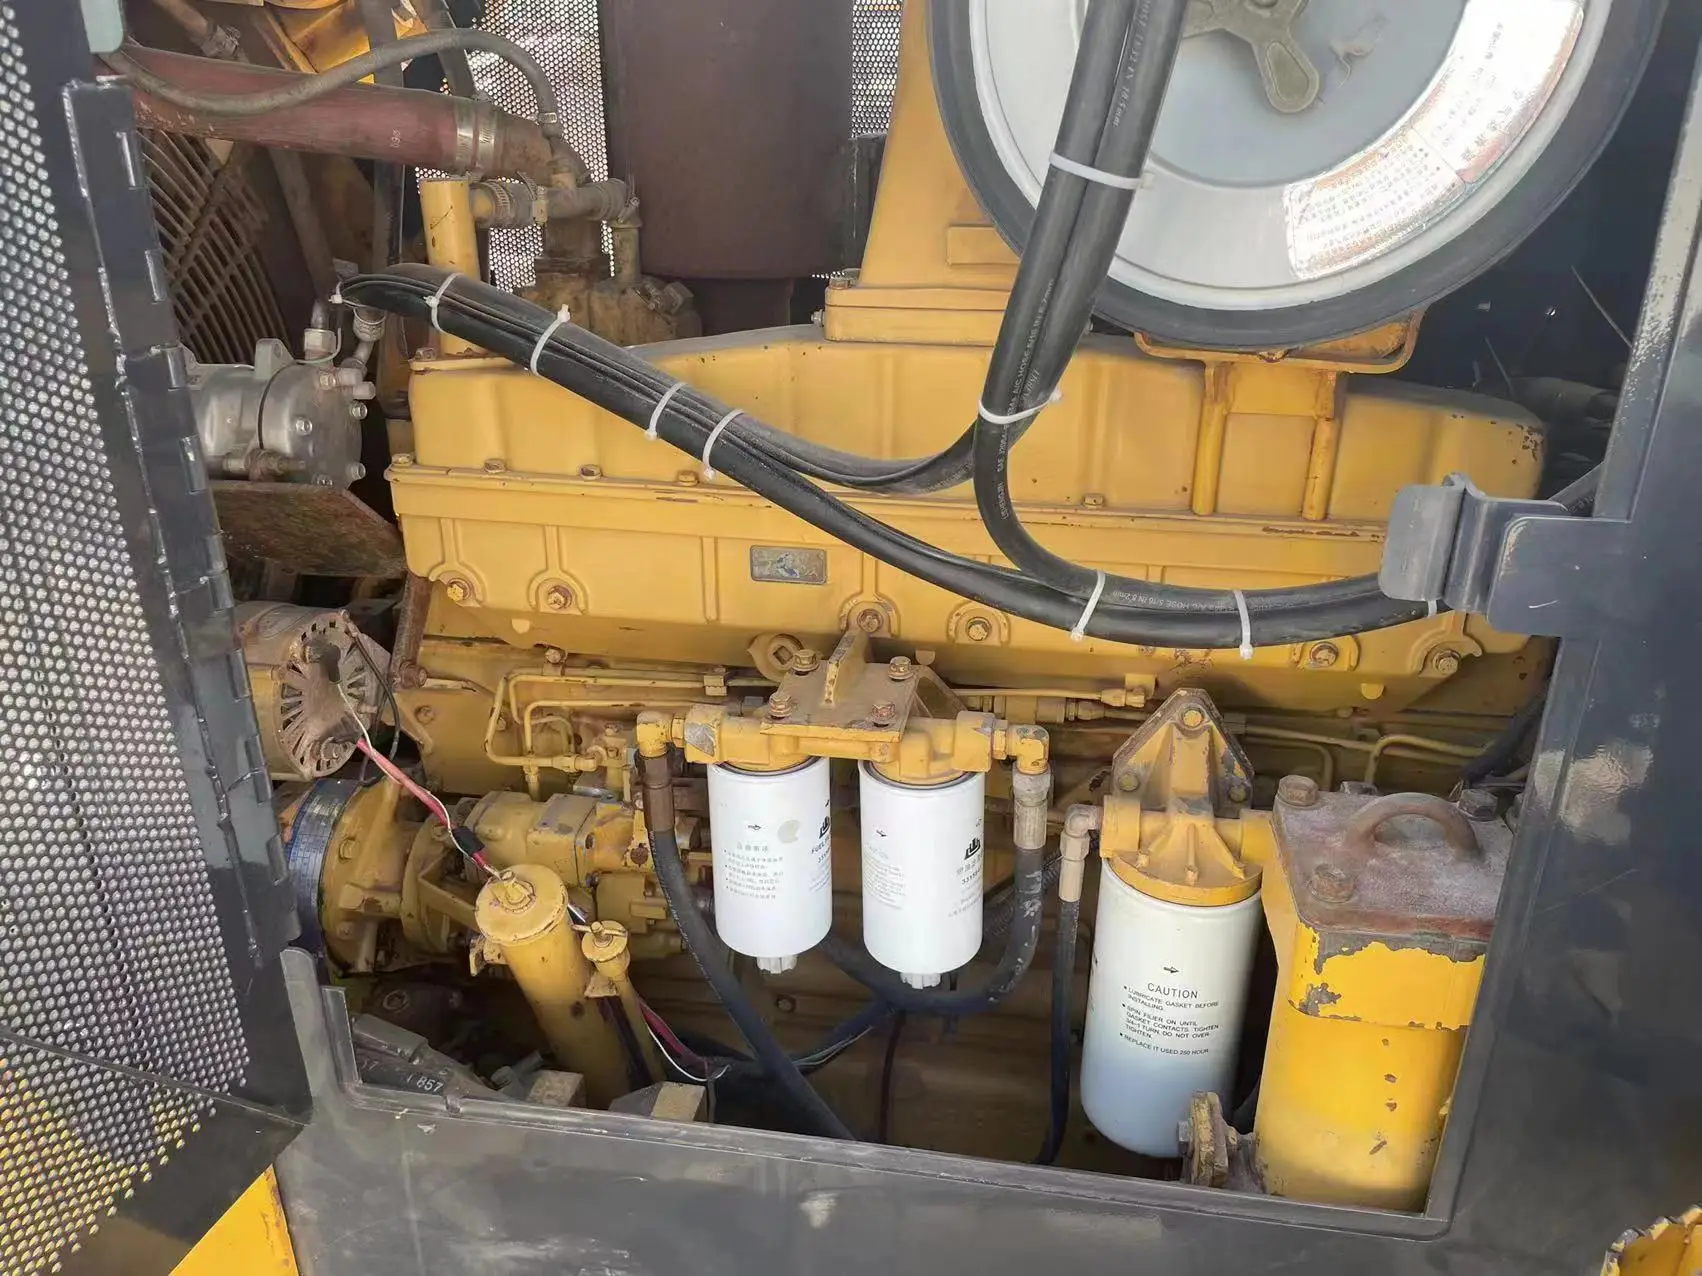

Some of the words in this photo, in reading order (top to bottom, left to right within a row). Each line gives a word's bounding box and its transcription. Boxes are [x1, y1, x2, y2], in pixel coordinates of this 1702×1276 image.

[1128, 987, 1163, 1004] LUBRICATE
[1165, 1001, 1192, 1009] GASKET
[1195, 1001, 1219, 1009] BEFORE
[1147, 983, 1198, 999] CAUTION
[1126, 1012, 1150, 1025] GASKET
[1127, 1006, 1141, 1016] SPIN
[1124, 1034, 1151, 1049] REPLACE
[416, 1076, 444, 1092] 857
